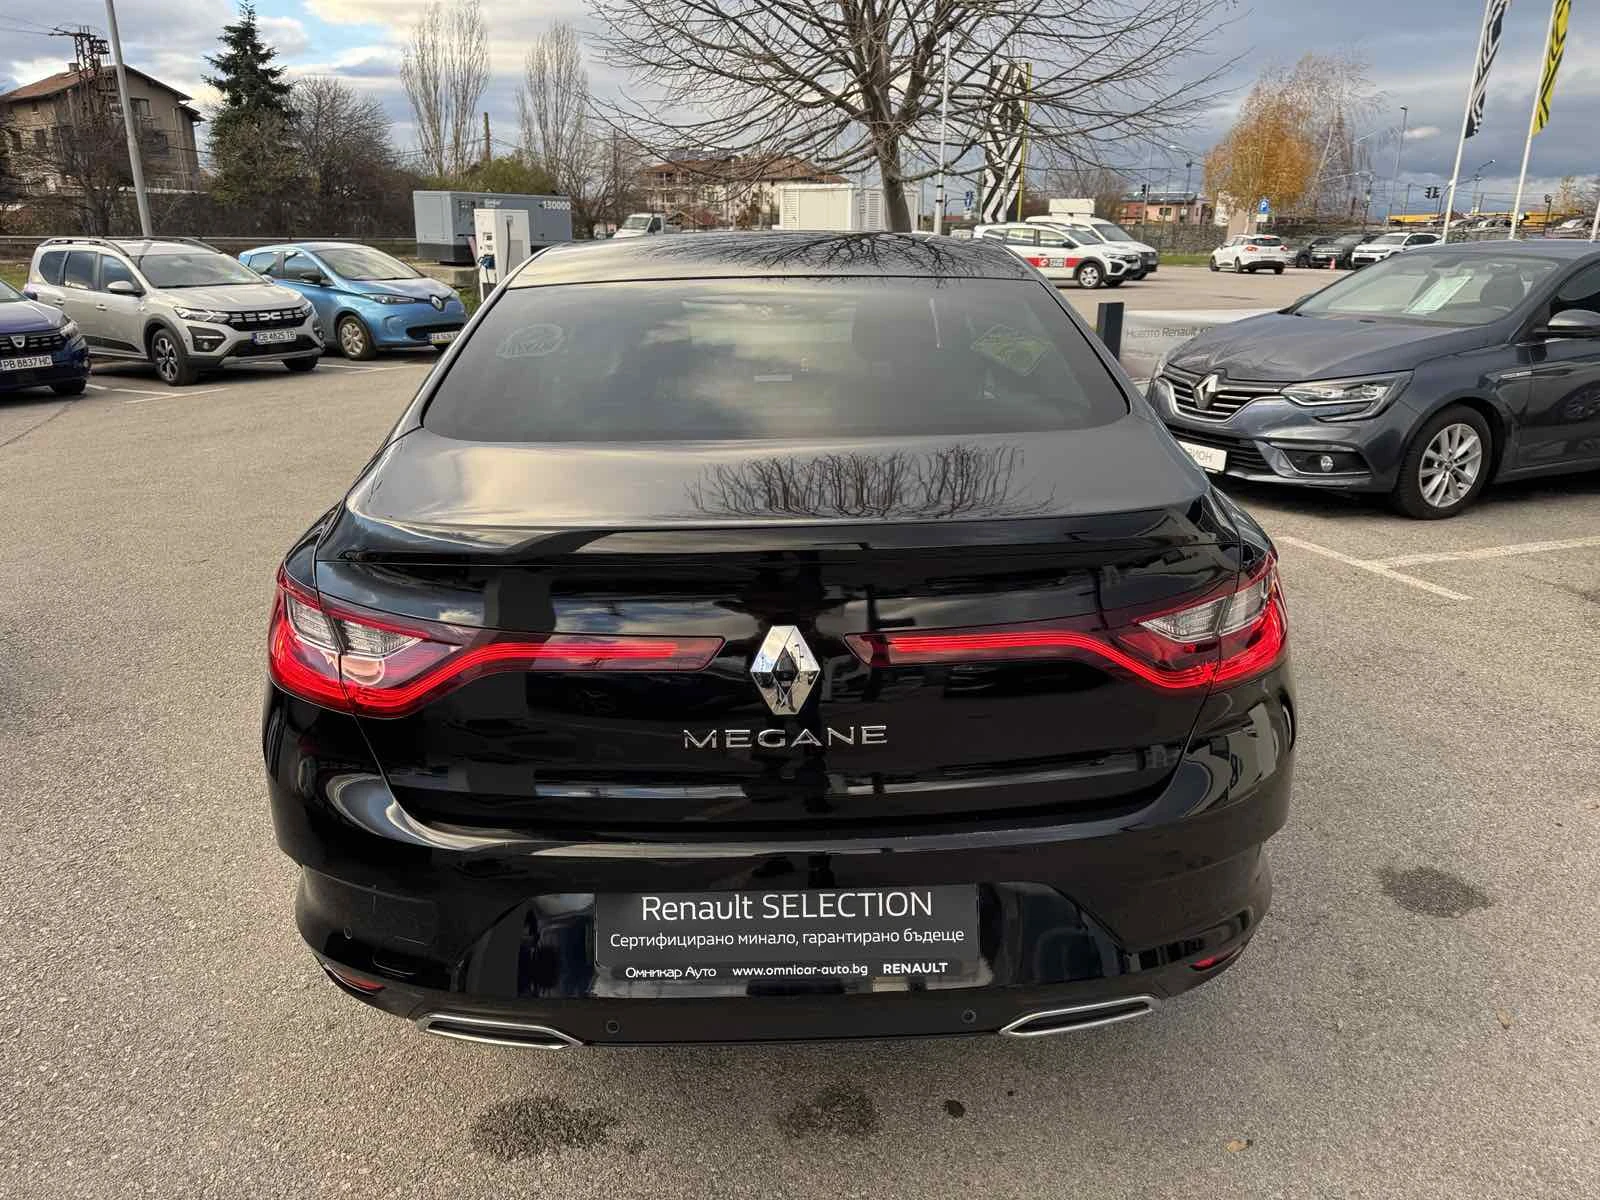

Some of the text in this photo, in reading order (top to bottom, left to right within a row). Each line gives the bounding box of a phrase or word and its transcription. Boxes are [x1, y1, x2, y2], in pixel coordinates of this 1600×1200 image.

[683, 725, 888, 748] MEGANE
[641, 891, 933, 921] Renault SELECTION
[610, 928, 965, 949] Сертифицирано минало, гарантирано бъдеще
[625, 965, 717, 980] Омникар Ауто
[732, 963, 869, 977] www.omnicar-auto.bg
[883, 961, 948, 975] RENAULT
